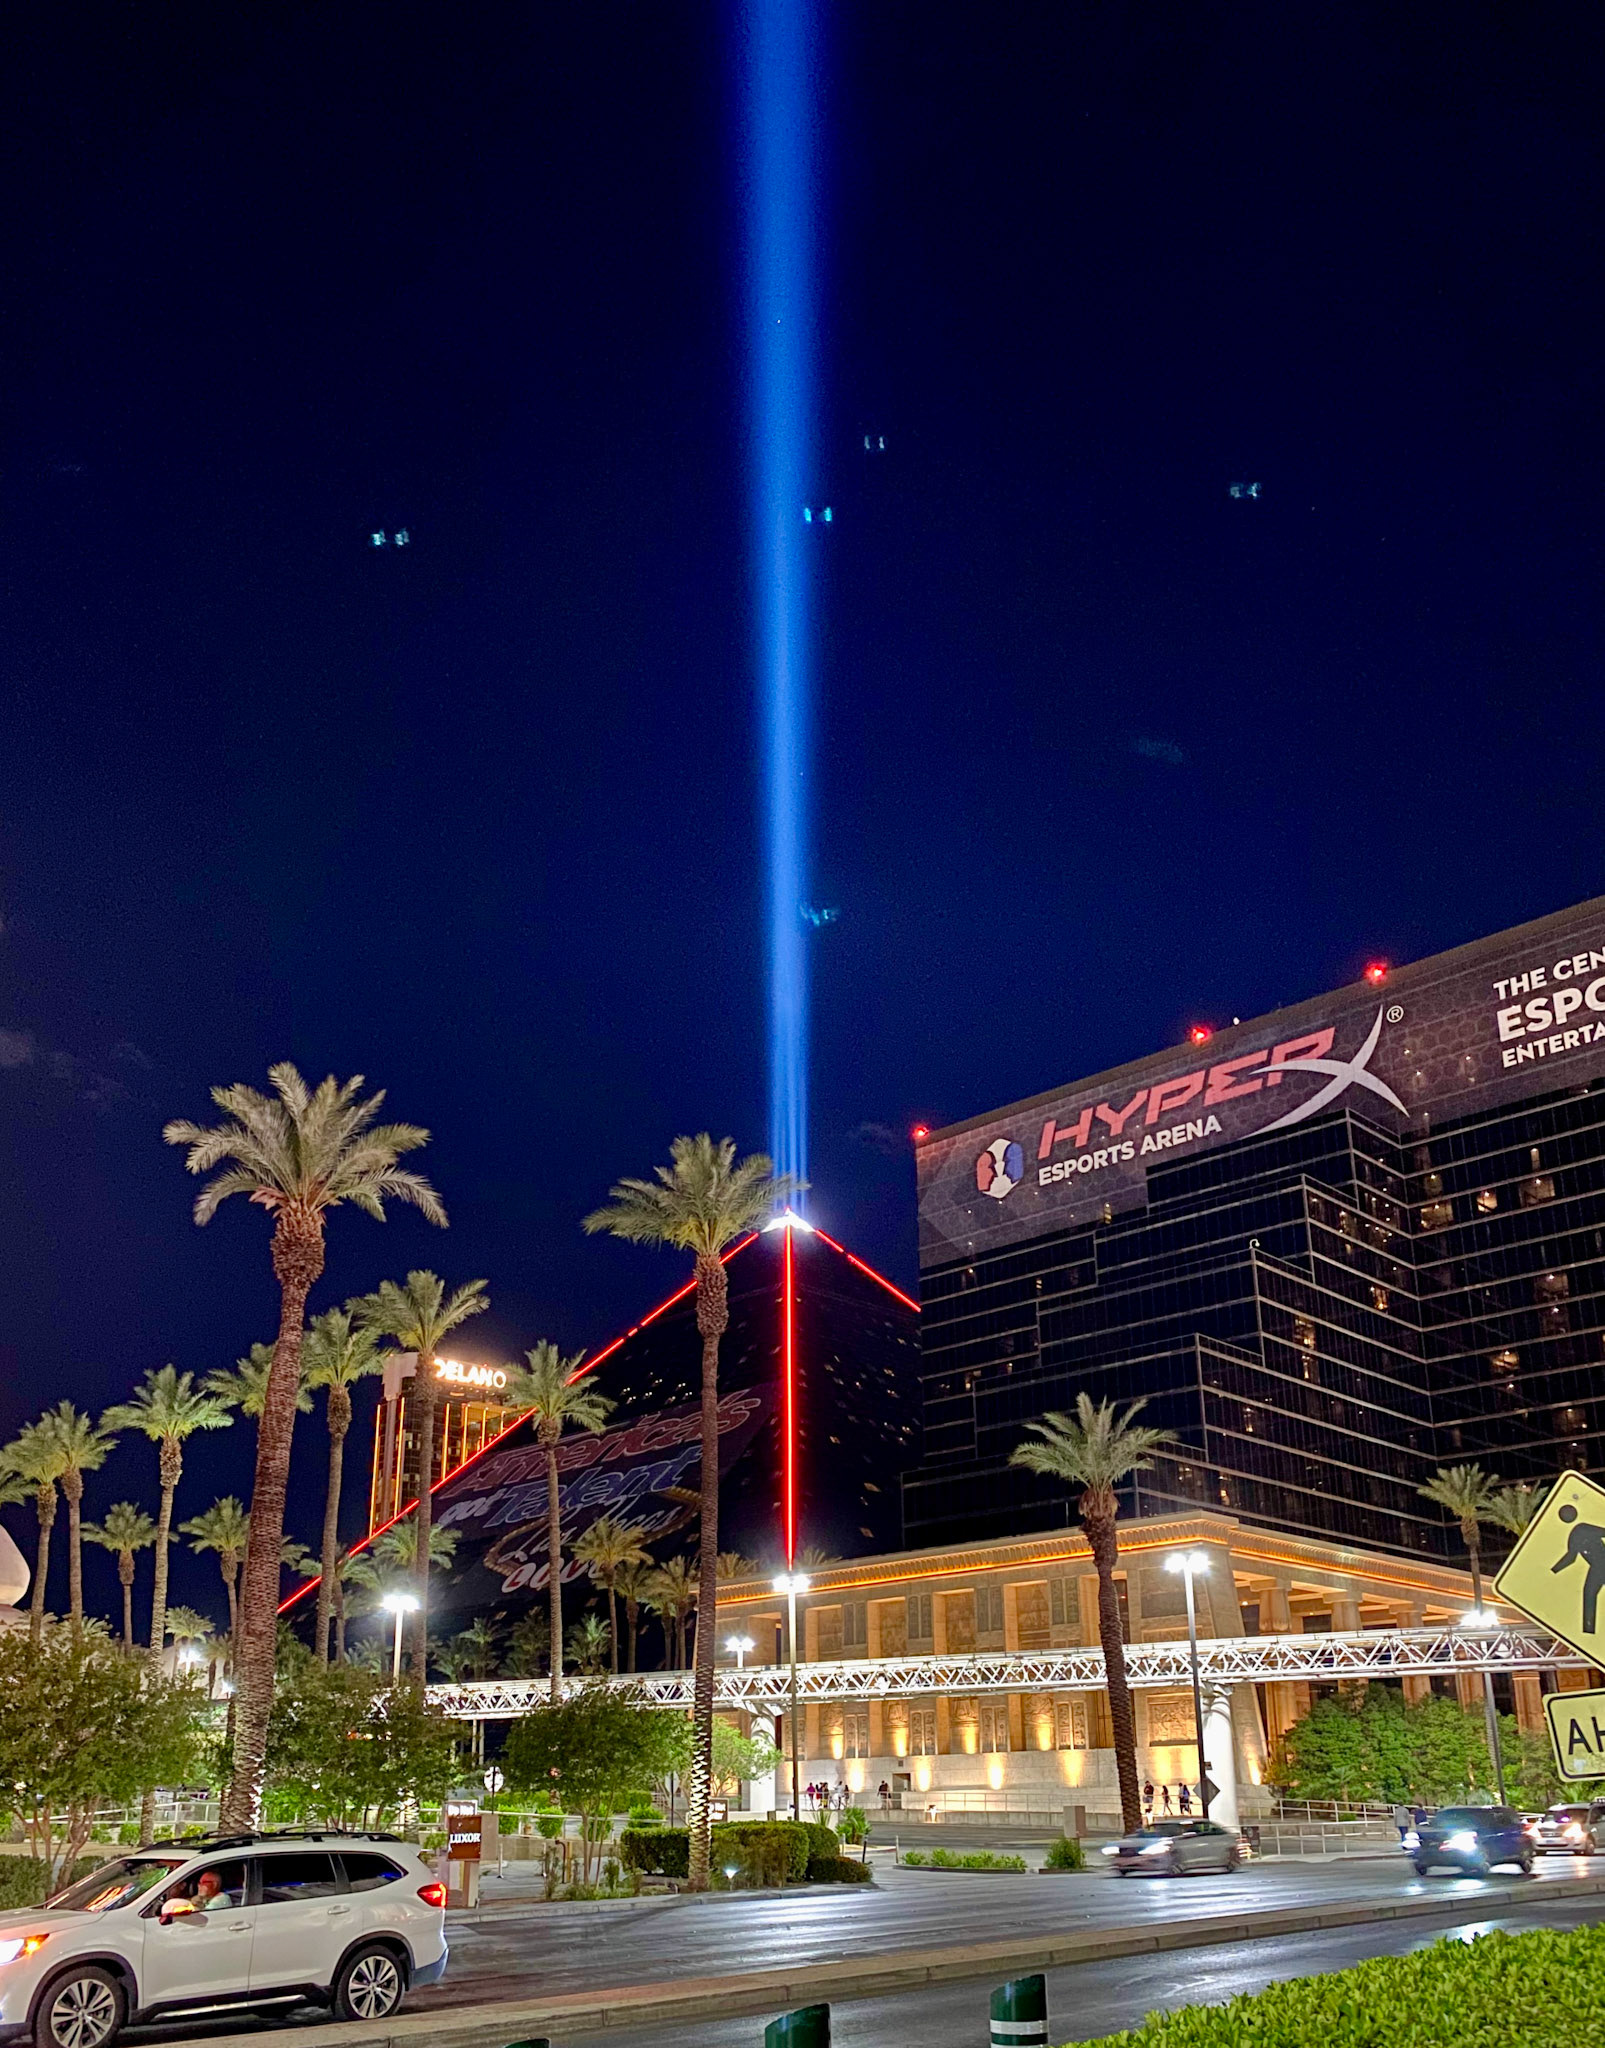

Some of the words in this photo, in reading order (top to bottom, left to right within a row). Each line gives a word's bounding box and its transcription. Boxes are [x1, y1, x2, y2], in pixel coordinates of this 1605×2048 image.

[1493, 967, 1547, 1000] THE
[1038, 1140, 1135, 1187] ESPORTS
[1140, 1114, 1222, 1156] ARENA
[450, 1832, 481, 1844] LUXOR
